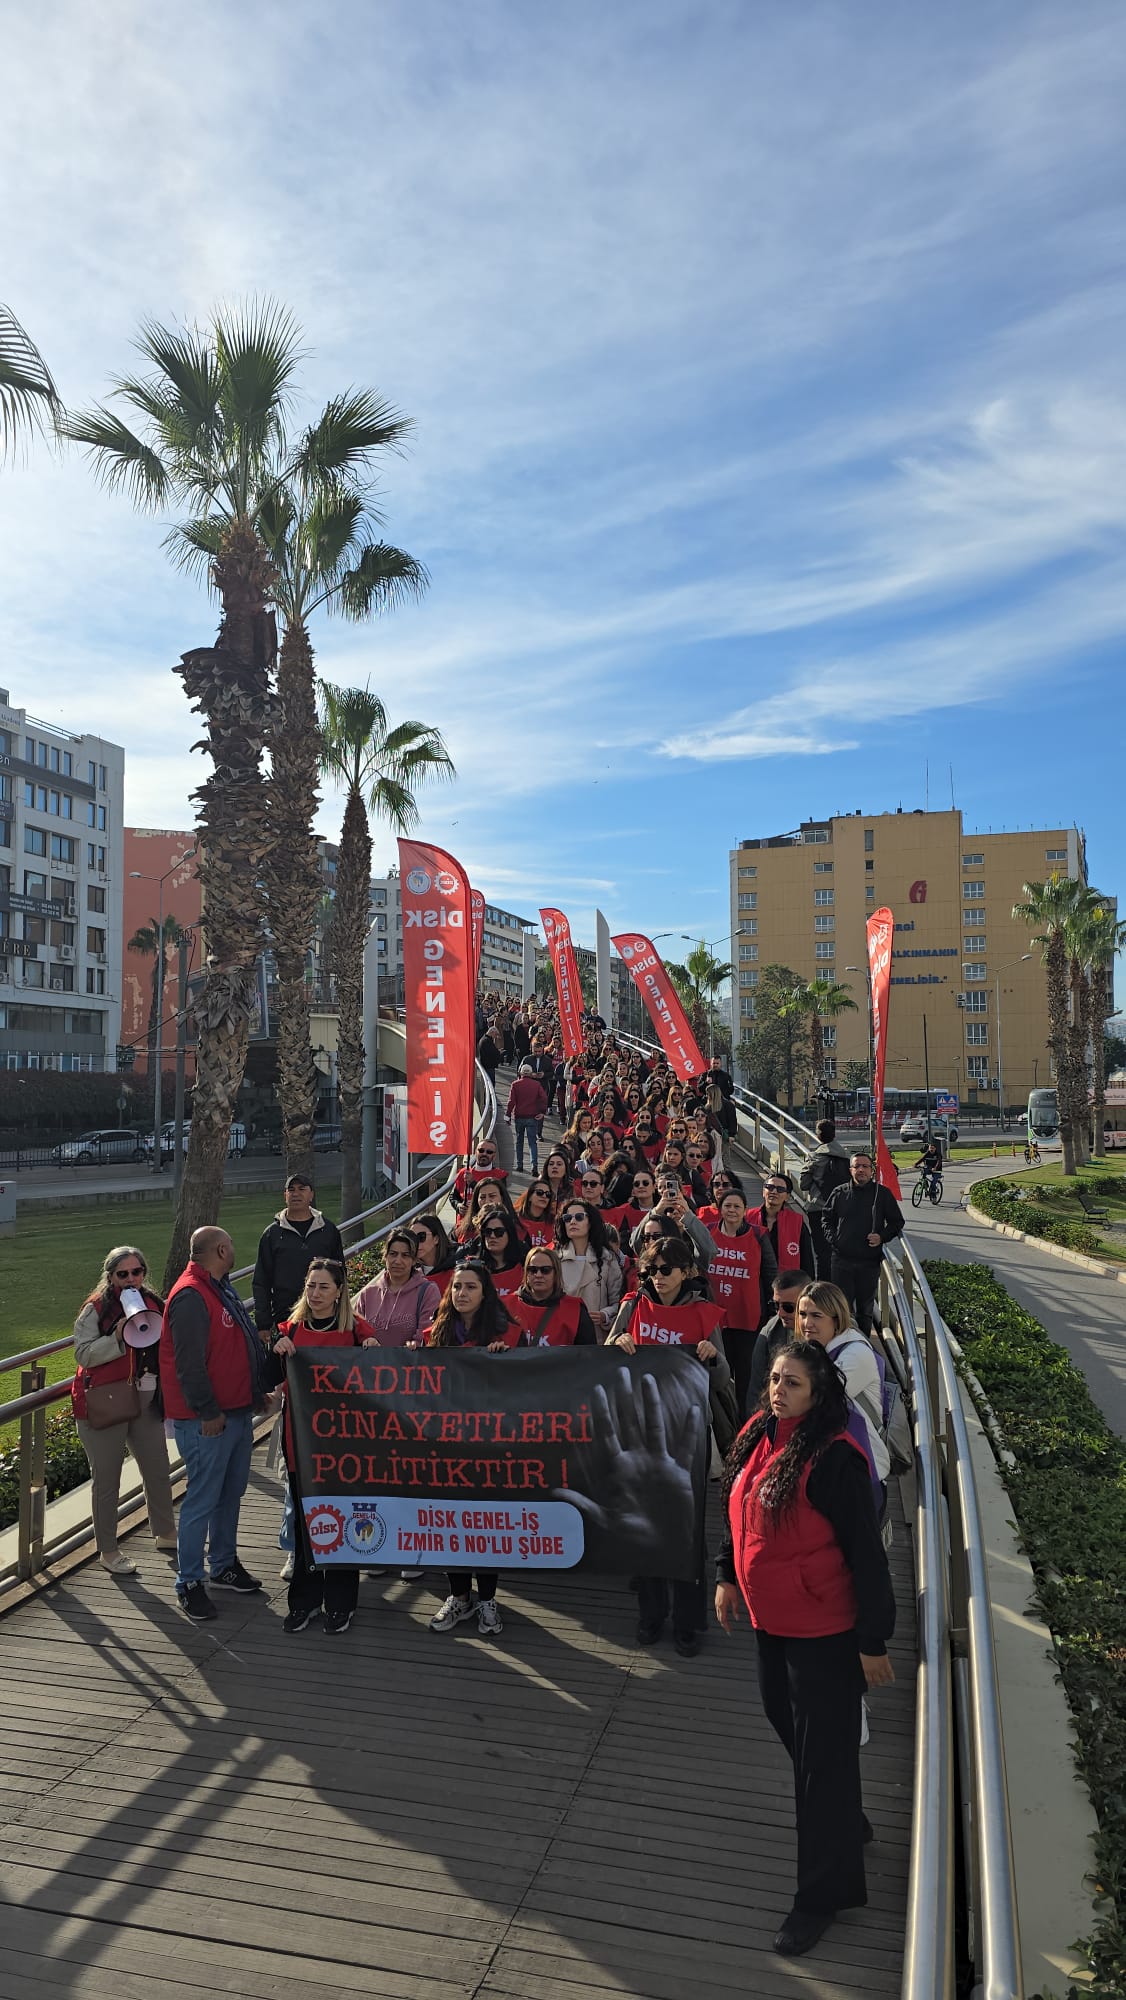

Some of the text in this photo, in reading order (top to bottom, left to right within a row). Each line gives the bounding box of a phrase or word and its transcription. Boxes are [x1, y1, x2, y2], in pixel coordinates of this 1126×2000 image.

[708, 1263, 750, 1279] GENEL
[719, 1280, 733, 1297] İŞ
[640, 1322, 684, 1345] DİSK
[309, 1364, 446, 1395] KADIN
[311, 1402, 593, 1443] CİNAYETLERİ
[311, 1448, 549, 1489] POLİTİKTİR
[310, 1521, 338, 1537] DİSK
[418, 1505, 540, 1536] DİSK GENEL-İŞ
[397, 1527, 445, 1553] İZMİR
[449, 1536, 460, 1553] 6
[465, 1534, 513, 1556] NO'LU
[518, 1536, 565, 1561] ŞUBE
